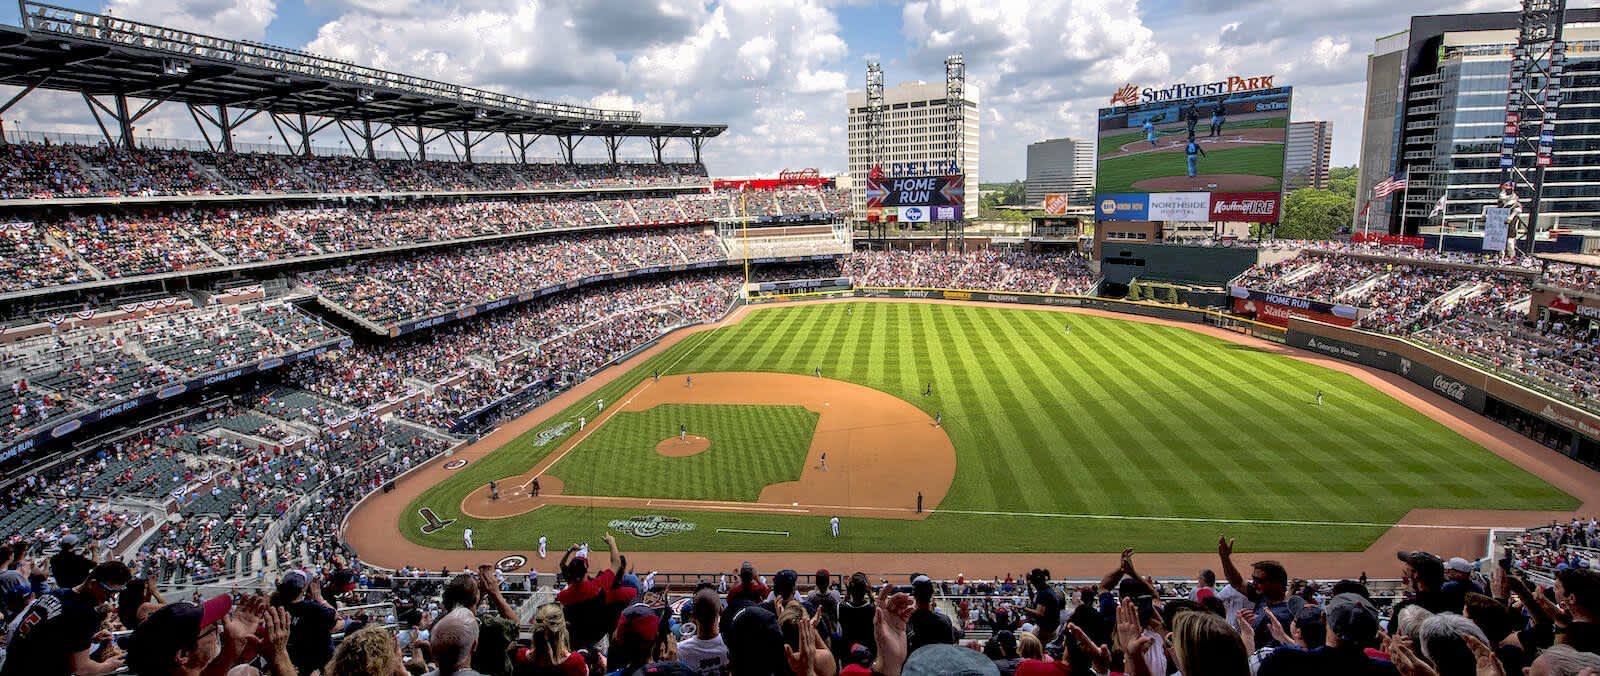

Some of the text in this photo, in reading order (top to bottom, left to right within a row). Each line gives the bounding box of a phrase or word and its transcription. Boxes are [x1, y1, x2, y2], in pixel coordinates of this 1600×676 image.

[1226, 75, 1274, 92] PARK
[893, 178, 937, 191] HOME
[900, 190, 930, 203] RUN
[1151, 201, 1207, 209] NORTHSIDE
[1265, 294, 1310, 309] HOME RUN
[414, 320, 432, 330] HOME
[1317, 342, 1360, 357] Georgia Power
[203, 370, 242, 386] HOME RUN
[99, 400, 139, 420] HOME RUN
[17, 438, 34, 453] RUN
